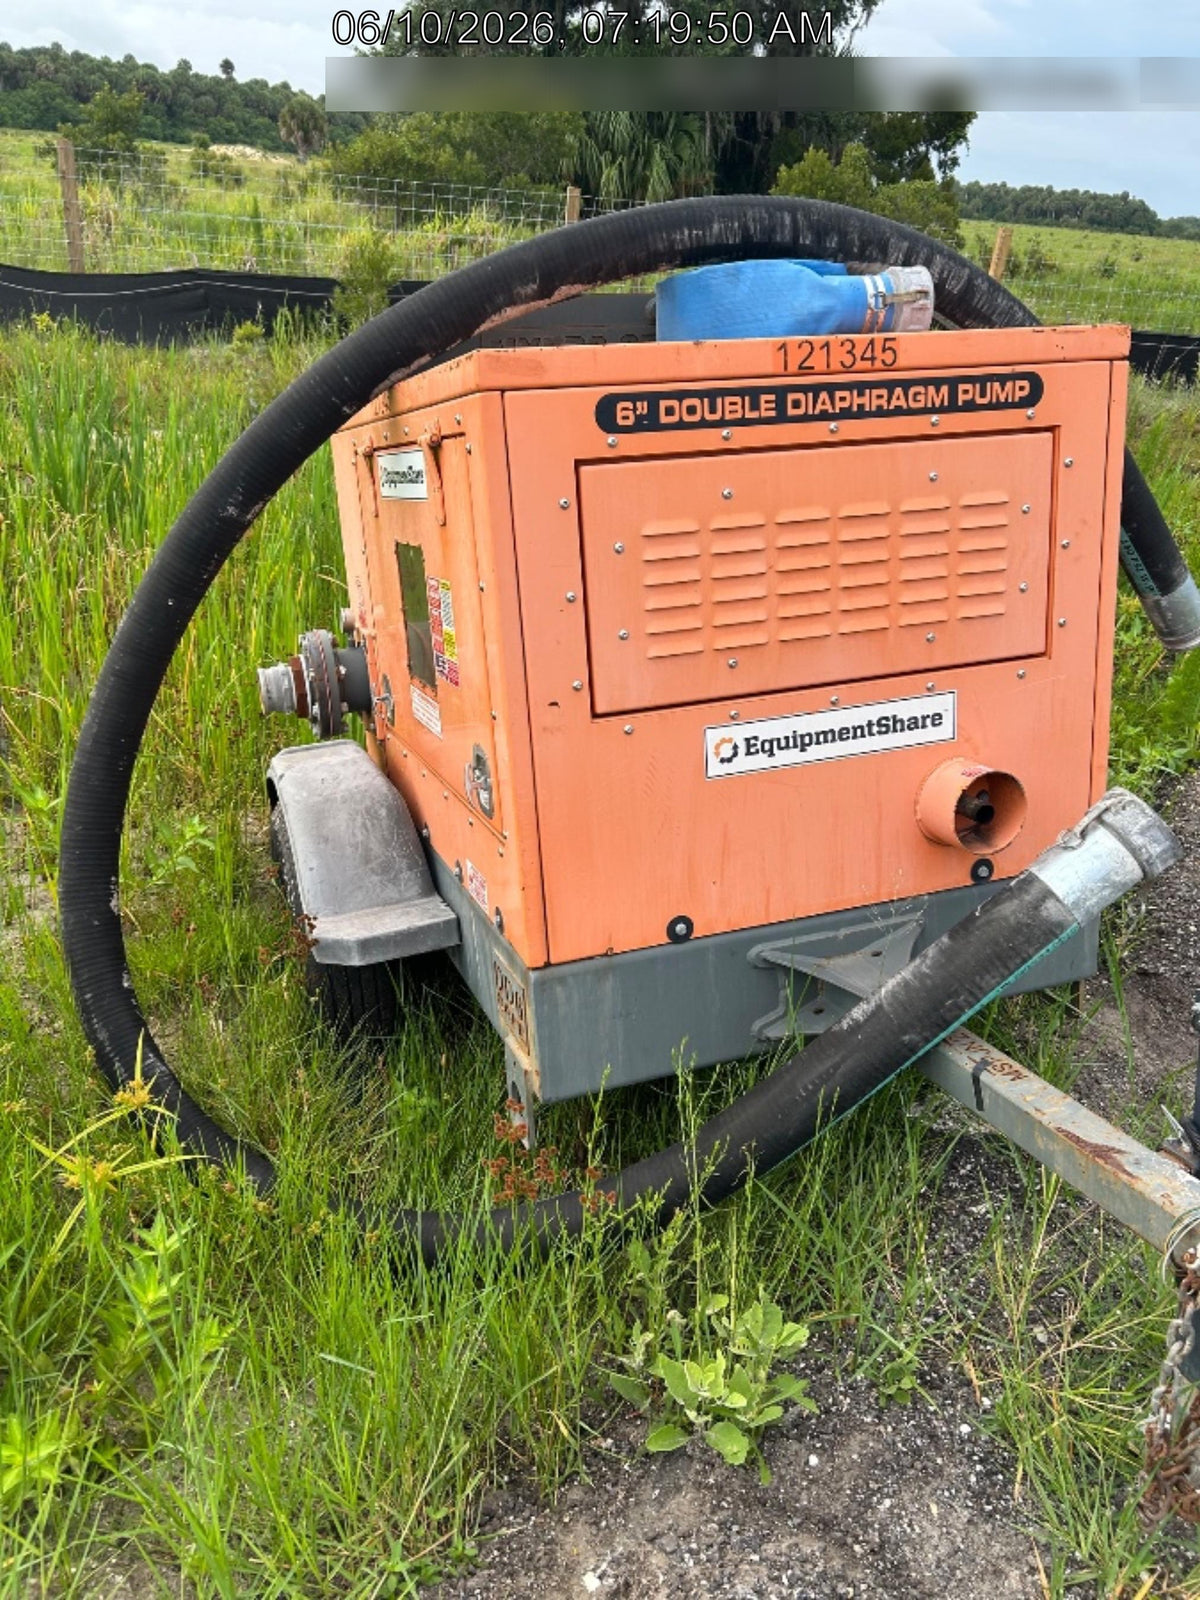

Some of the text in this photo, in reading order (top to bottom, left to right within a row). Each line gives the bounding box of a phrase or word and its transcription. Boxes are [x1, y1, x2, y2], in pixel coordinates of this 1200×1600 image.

[776, 337, 898, 372] 121345
[659, 393, 777, 424] DOUBLE
[786, 384, 949, 416] DIAPHRAGM
[957, 379, 1031, 406] PUMP
[744, 711, 943, 757] EquipmentShare
